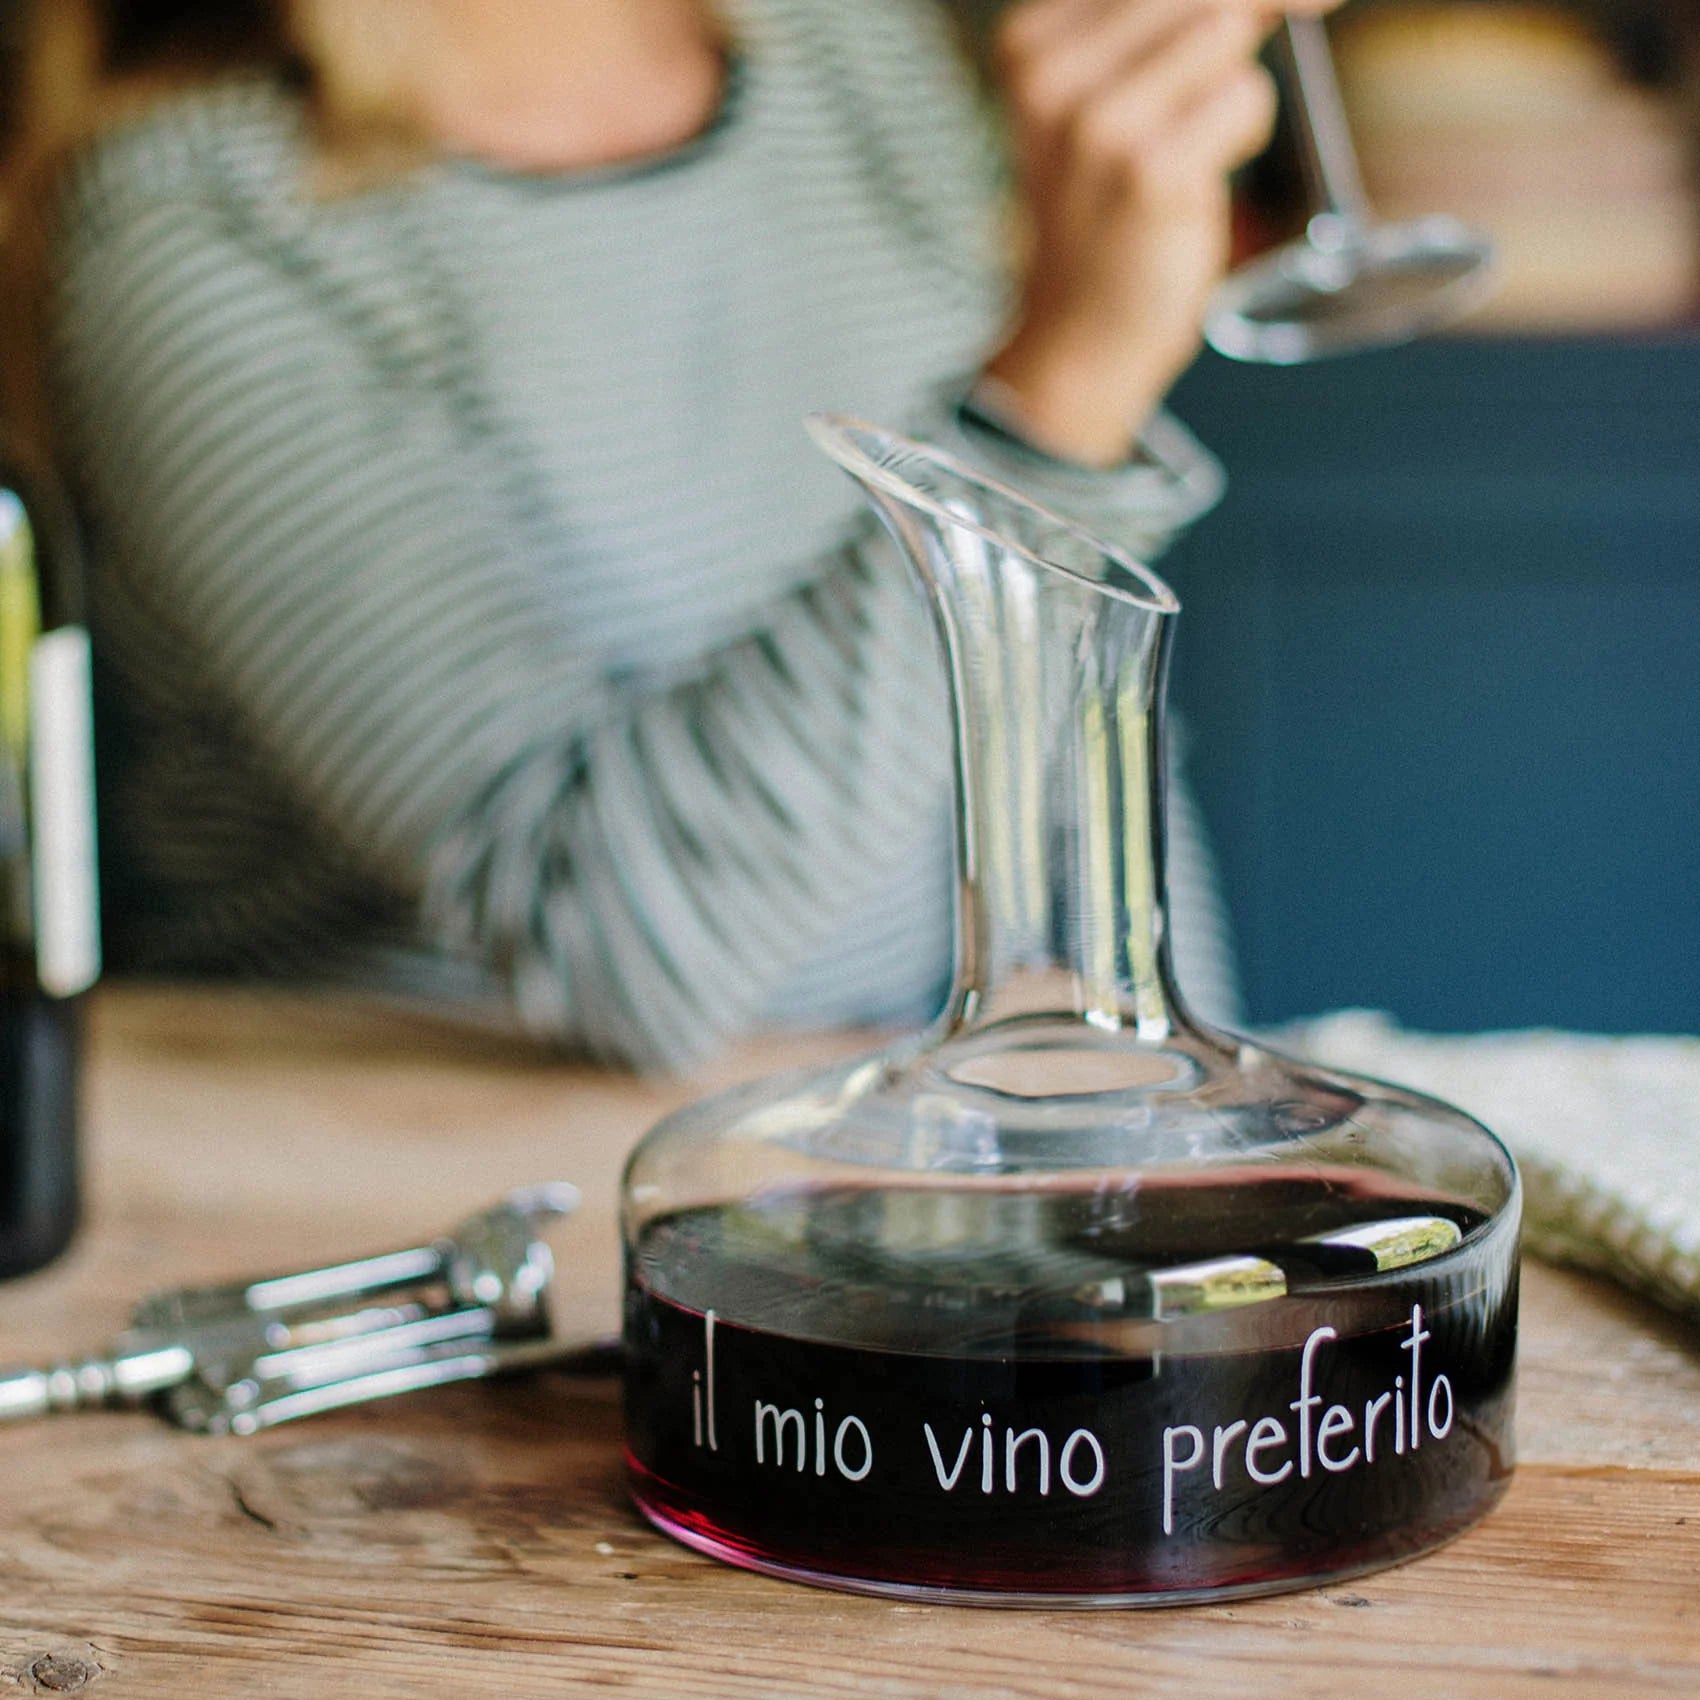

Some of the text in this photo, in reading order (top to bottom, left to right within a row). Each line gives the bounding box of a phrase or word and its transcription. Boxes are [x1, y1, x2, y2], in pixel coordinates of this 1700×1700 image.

[692, 1303, 1454, 1536] il mio vino preferito
